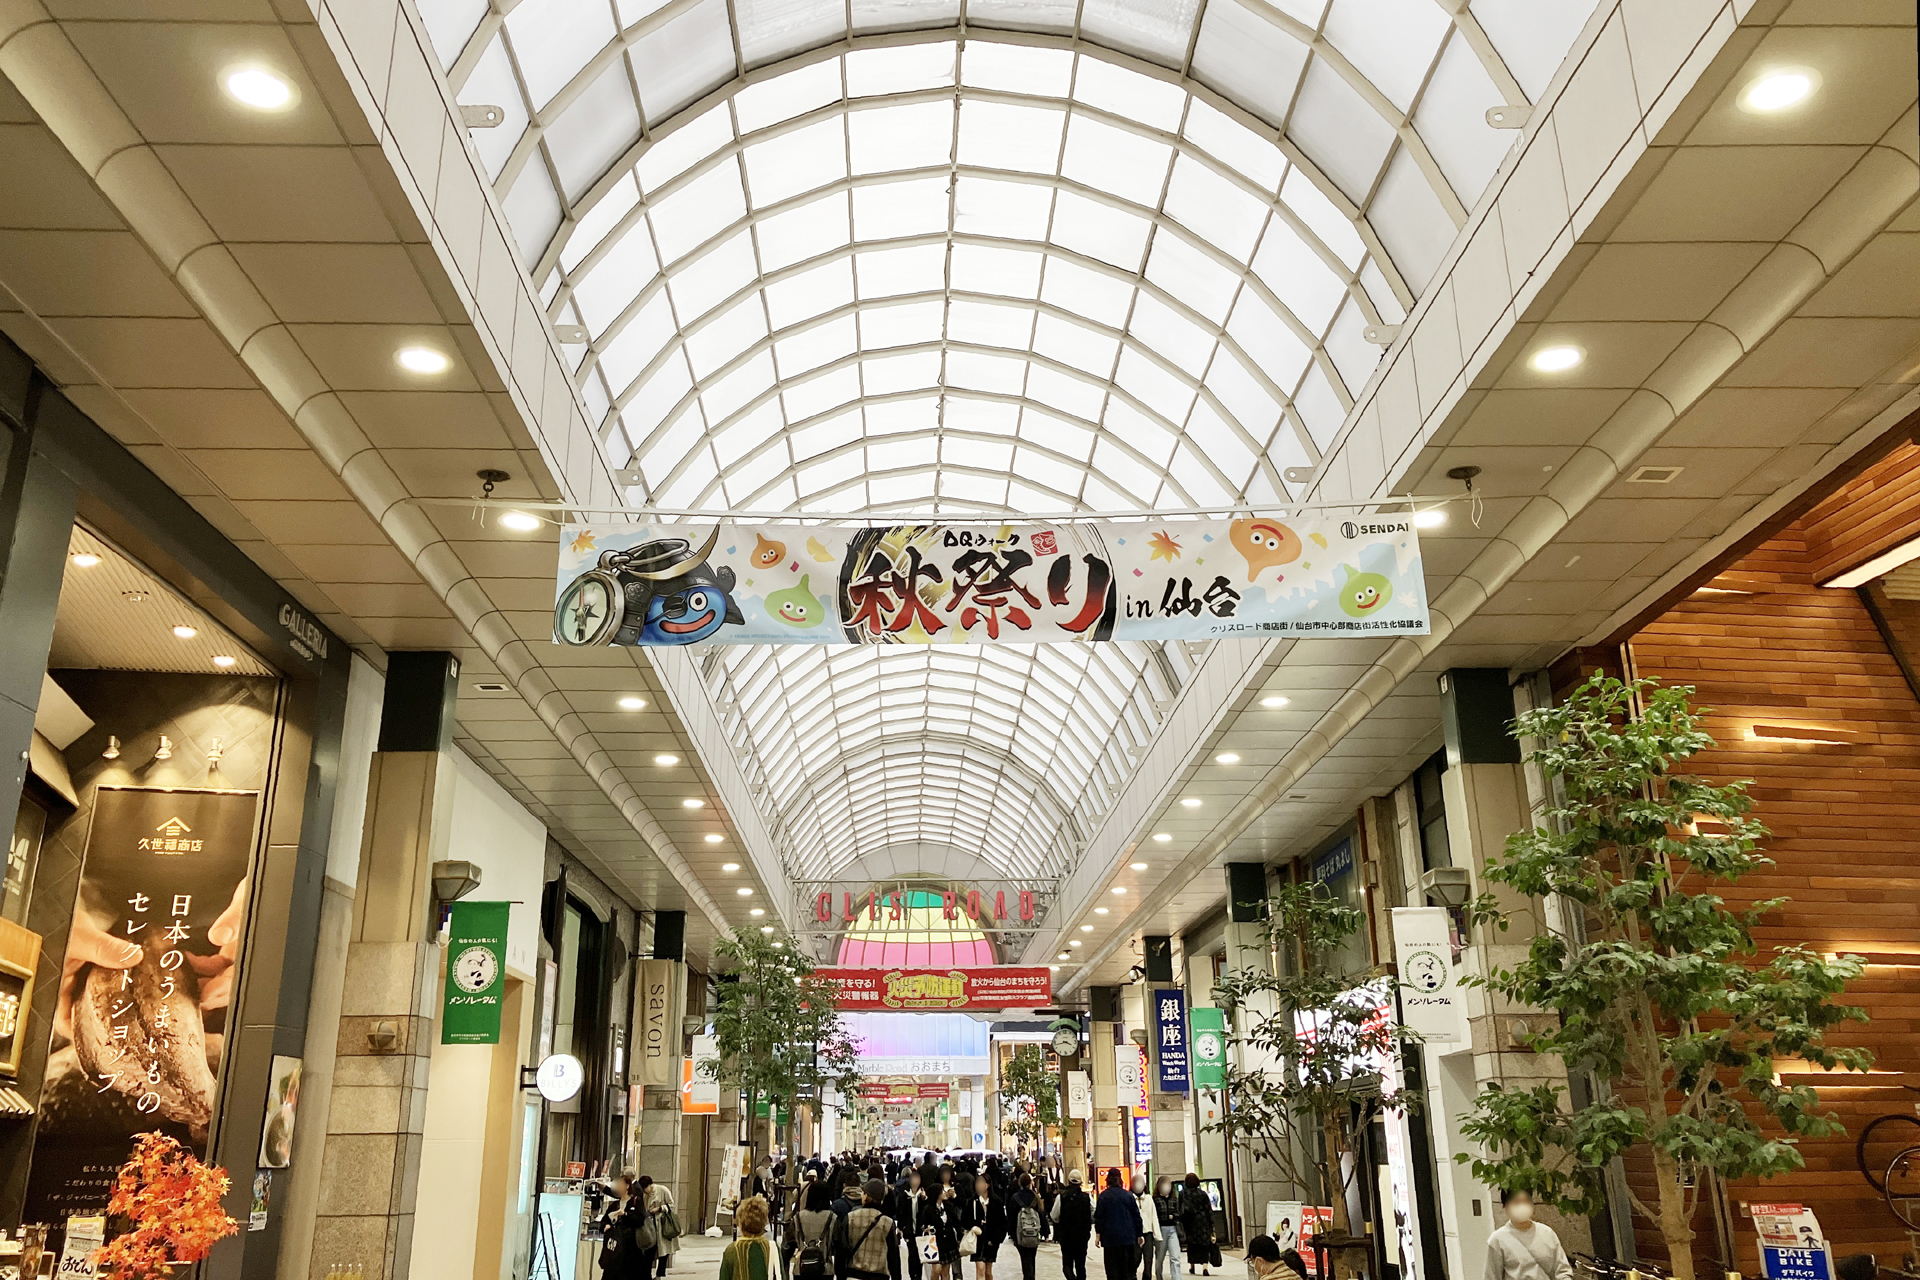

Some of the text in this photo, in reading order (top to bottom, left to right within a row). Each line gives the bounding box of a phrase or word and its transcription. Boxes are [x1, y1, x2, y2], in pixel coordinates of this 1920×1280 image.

[1359, 522, 1409, 535] SENDAI
[943, 529, 1020, 547] DQウォーク
[842, 546, 1110, 640] 秋祭り
[1126, 575, 1241, 618] in 仙台
[279, 604, 328, 659] GALLERIA
[1210, 621, 1288, 634] クリスロード商店街
[1295, 619, 1424, 631] 仙台市中心部商店街活性化協議会
[138, 837, 204, 852] 久世福商店
[817, 890, 1035, 922] CLIS ROAD
[887, 975, 964, 999] 火災予防運動
[970, 976, 1048, 988] 放火から仙台のまちを守ろう!
[97, 892, 150, 1094] セレクトショップ
[449, 996, 497, 1005] メンソレータム
[136, 894, 192, 1114] 日本のうまいもの
[1407, 998, 1451, 1006] メンソレータム
[646, 983, 665, 1059] savon
[1160, 998, 1182, 1047] 銀座
[885, 1063, 908, 1074] Road
[910, 1061, 951, 1073] おおまち
[540, 1077, 577, 1089] BILLY'S
[1778, 1249, 1812, 1258] DATE
[62, 1256, 93, 1275] おでん
[1779, 1258, 1813, 1266] BIKE
[1781, 1269, 1815, 1277] ダテバイク
